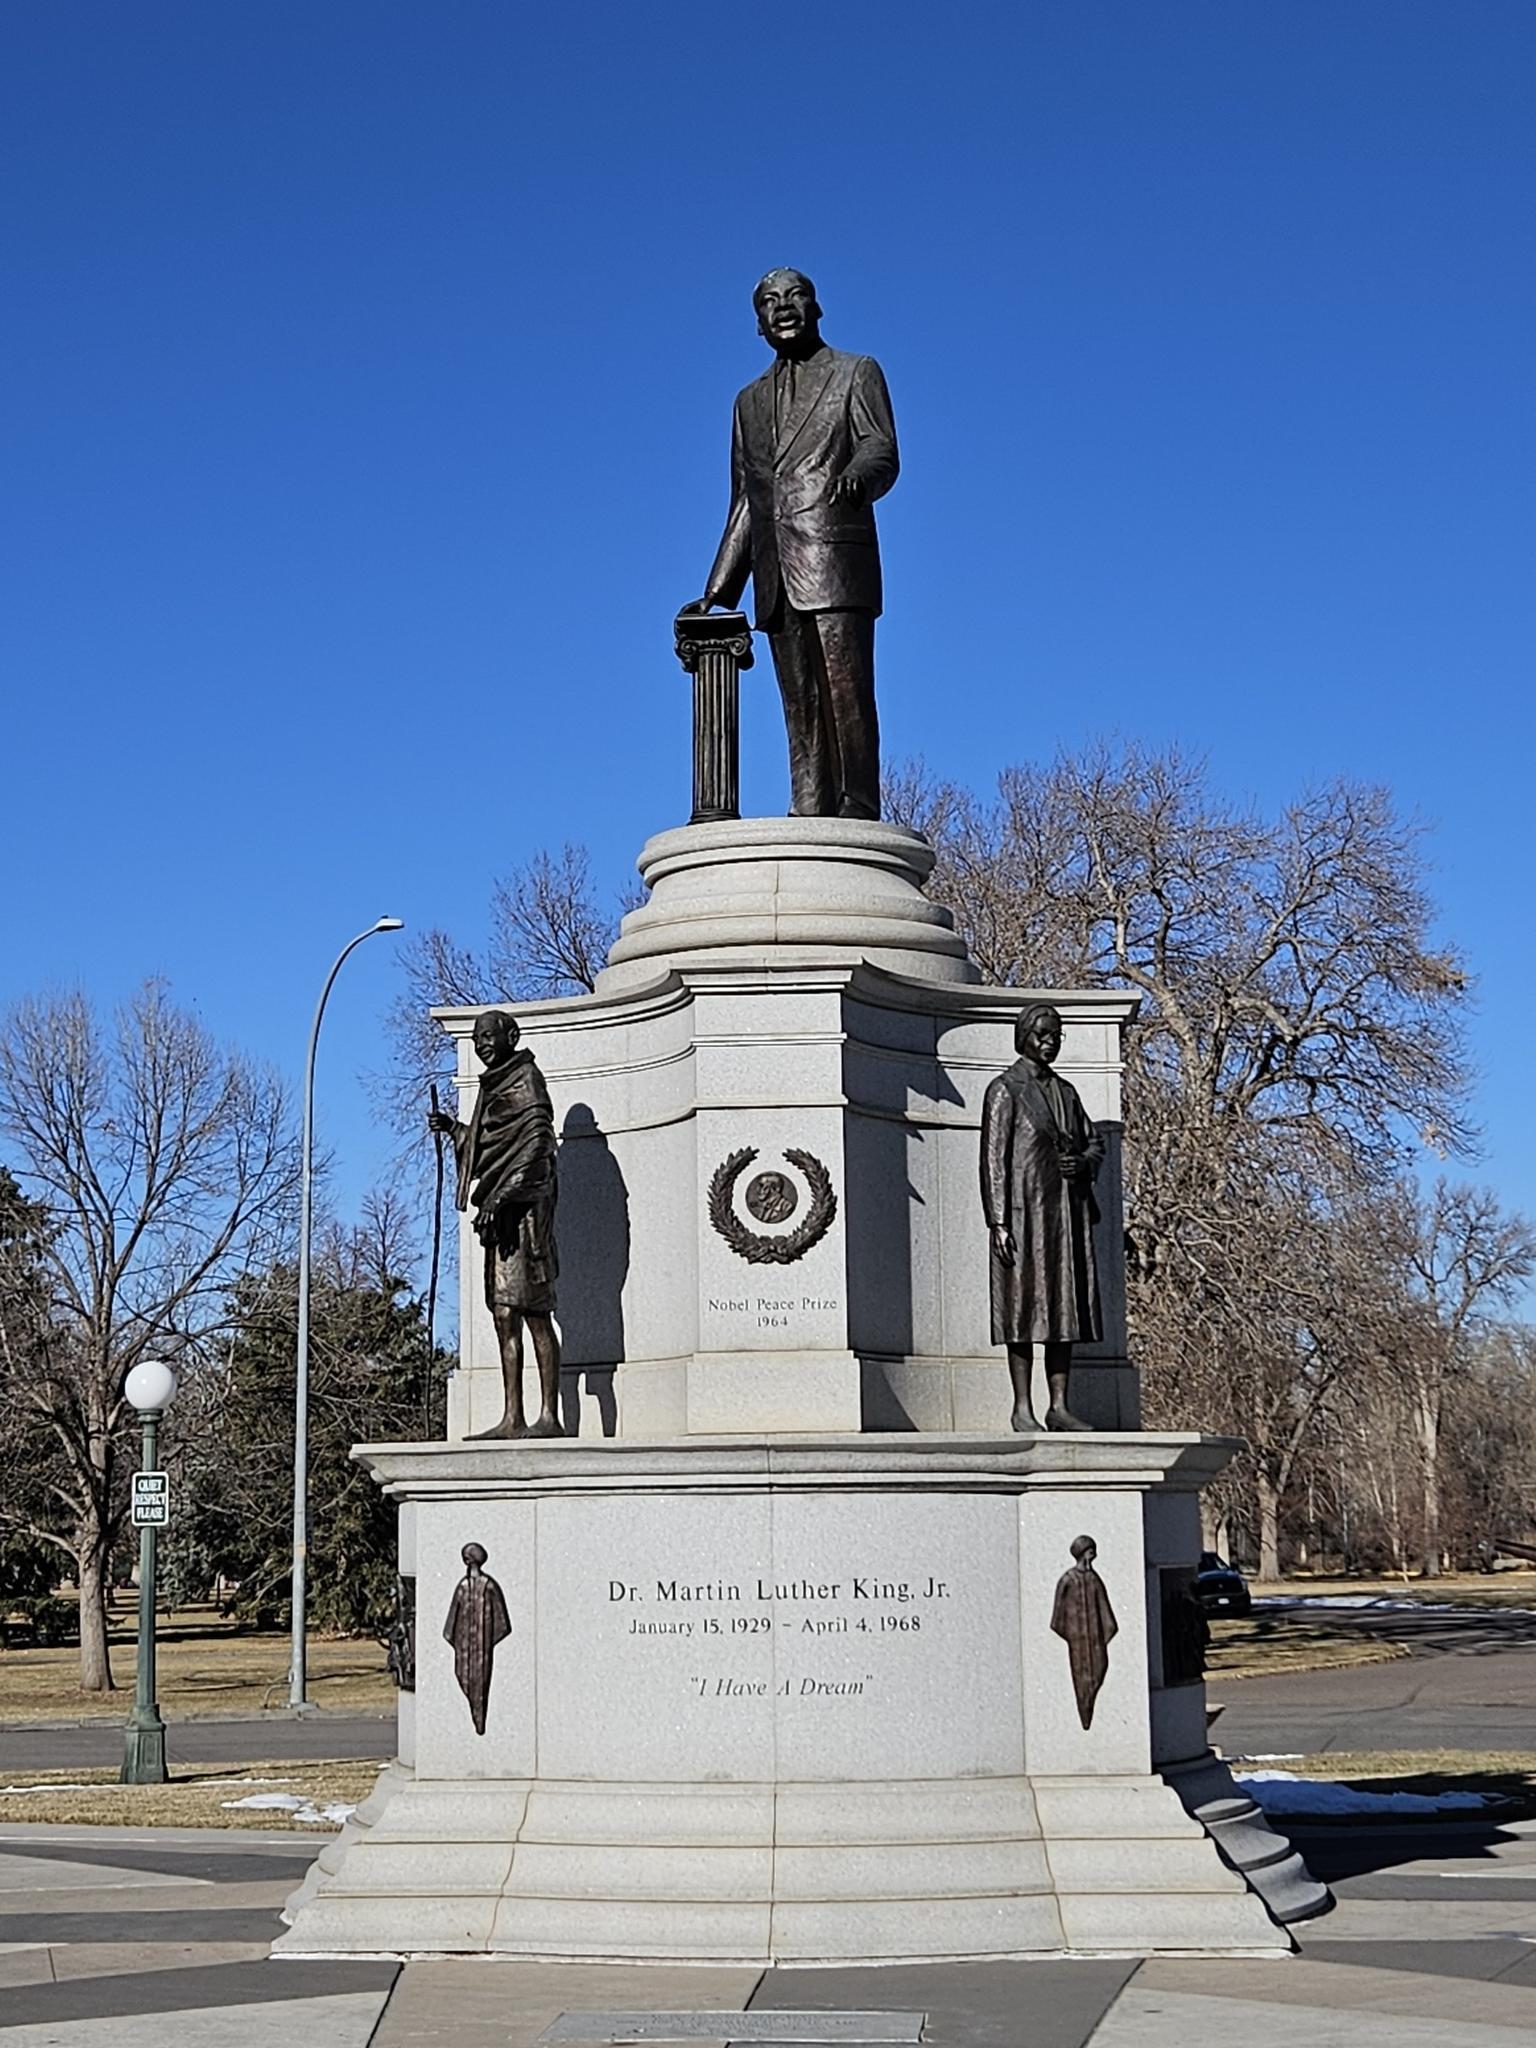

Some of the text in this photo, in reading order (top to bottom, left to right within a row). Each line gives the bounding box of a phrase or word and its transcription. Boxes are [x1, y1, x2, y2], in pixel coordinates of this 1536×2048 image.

[708, 1297, 837, 1311] Nobel Peace Prize
[757, 1316, 788, 1327] 1964
[138, 1479, 162, 1492] QUIET
[135, 1493, 166, 1505] RESPECT
[137, 1507, 163, 1519] PLEASE
[609, 1581, 642, 1601] Dr.
[656, 1580, 741, 1601] Martin
[757, 1580, 840, 1600] Luther
[923, 1577, 950, 1598] Jr.
[629, 1619, 694, 1636] January
[703, 1619, 723, 1634] 15,
[731, 1618, 771, 1633] 1929
[801, 1617, 848, 1636] April
[856, 1617, 872, 1633] 4,
[881, 1616, 921, 1632] 1968
[715, 1678, 767, 1696] Have
[777, 1678, 790, 1695] A
